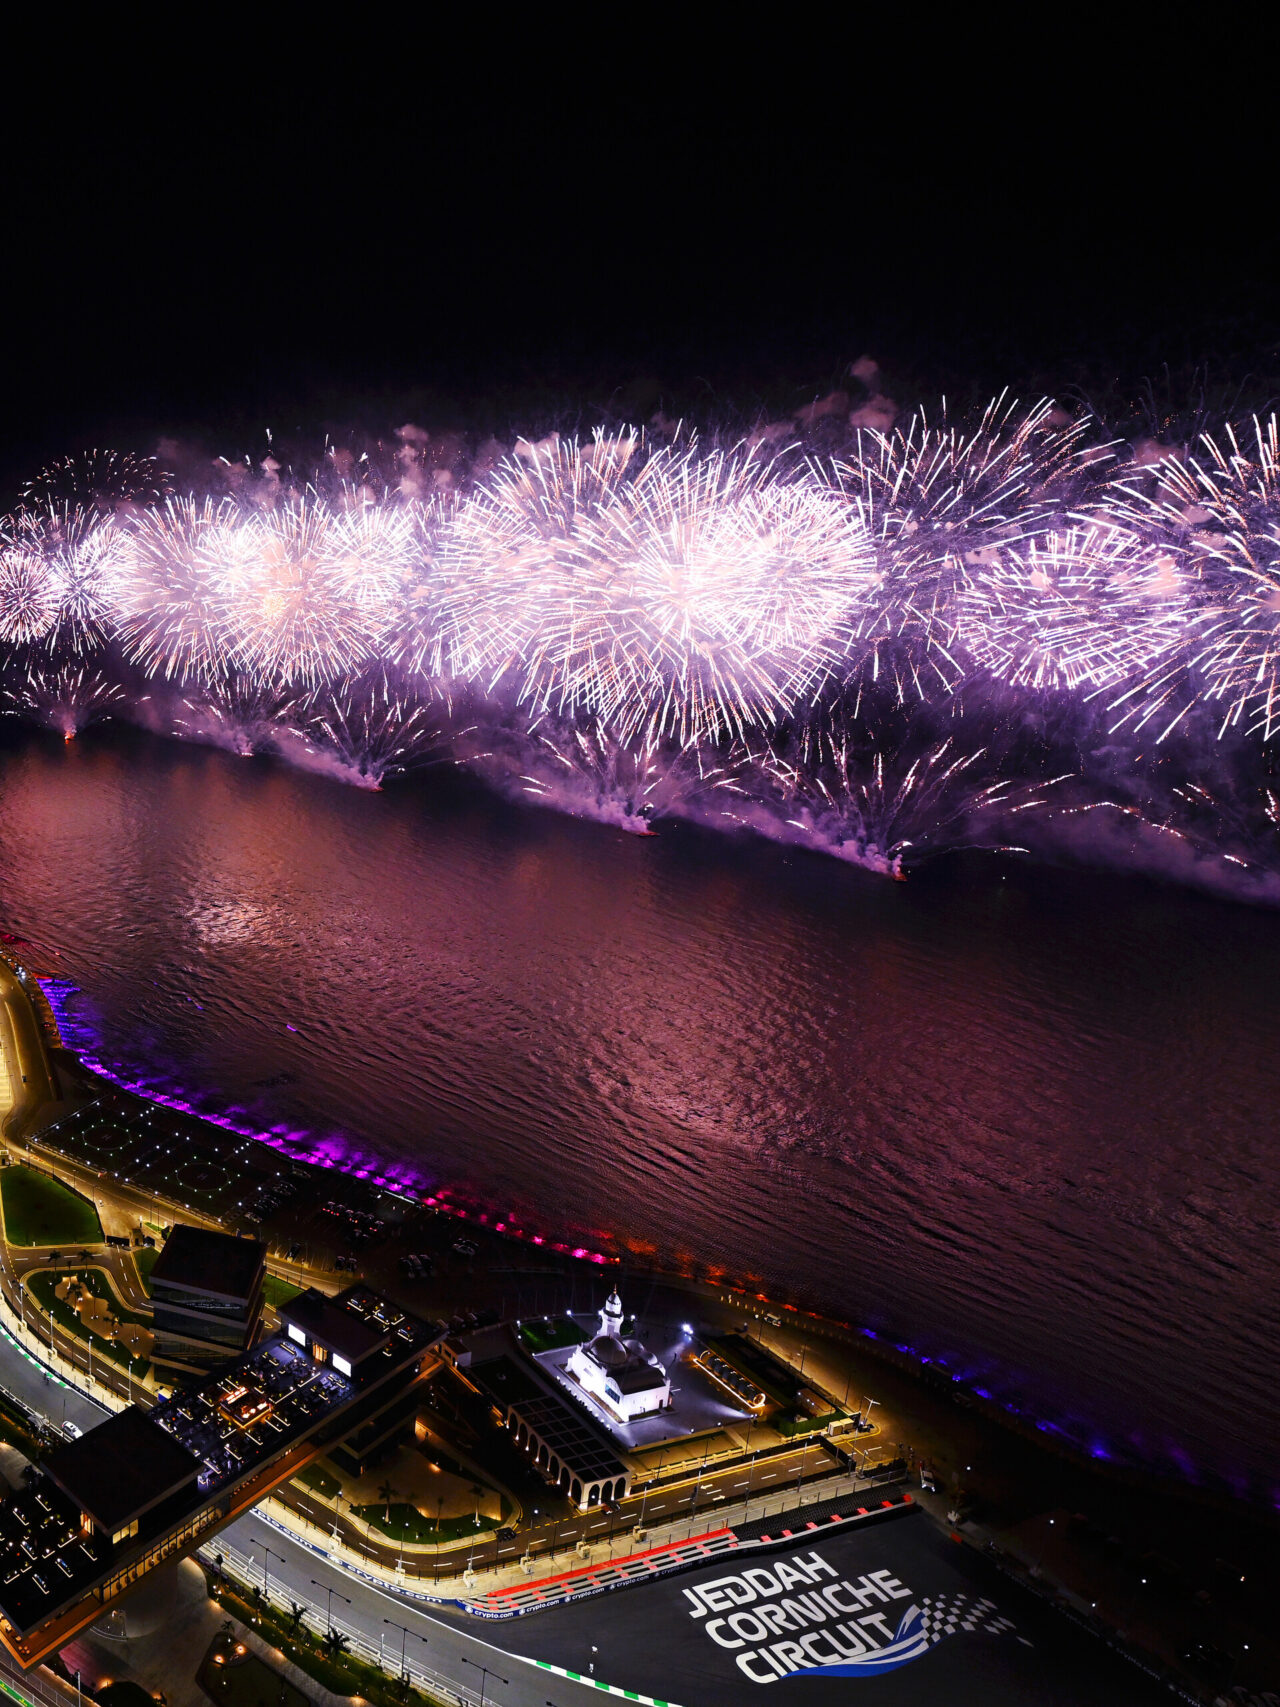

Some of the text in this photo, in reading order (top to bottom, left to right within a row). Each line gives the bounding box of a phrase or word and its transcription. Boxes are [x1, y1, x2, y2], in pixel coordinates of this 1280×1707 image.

[250, 1507, 442, 1604] ypto.com crypto.com
[681, 1551, 840, 1619] JEDDAH
[474, 1610, 514, 1619] crypto.com
[526, 1599, 560, 1613] crypto.com
[571, 1586, 605, 1600] crypto.com
[616, 1574, 650, 1588] crypto.com
[704, 1569, 913, 1649] CORNICHE
[735, 1612, 895, 1684] CIRCUIT
